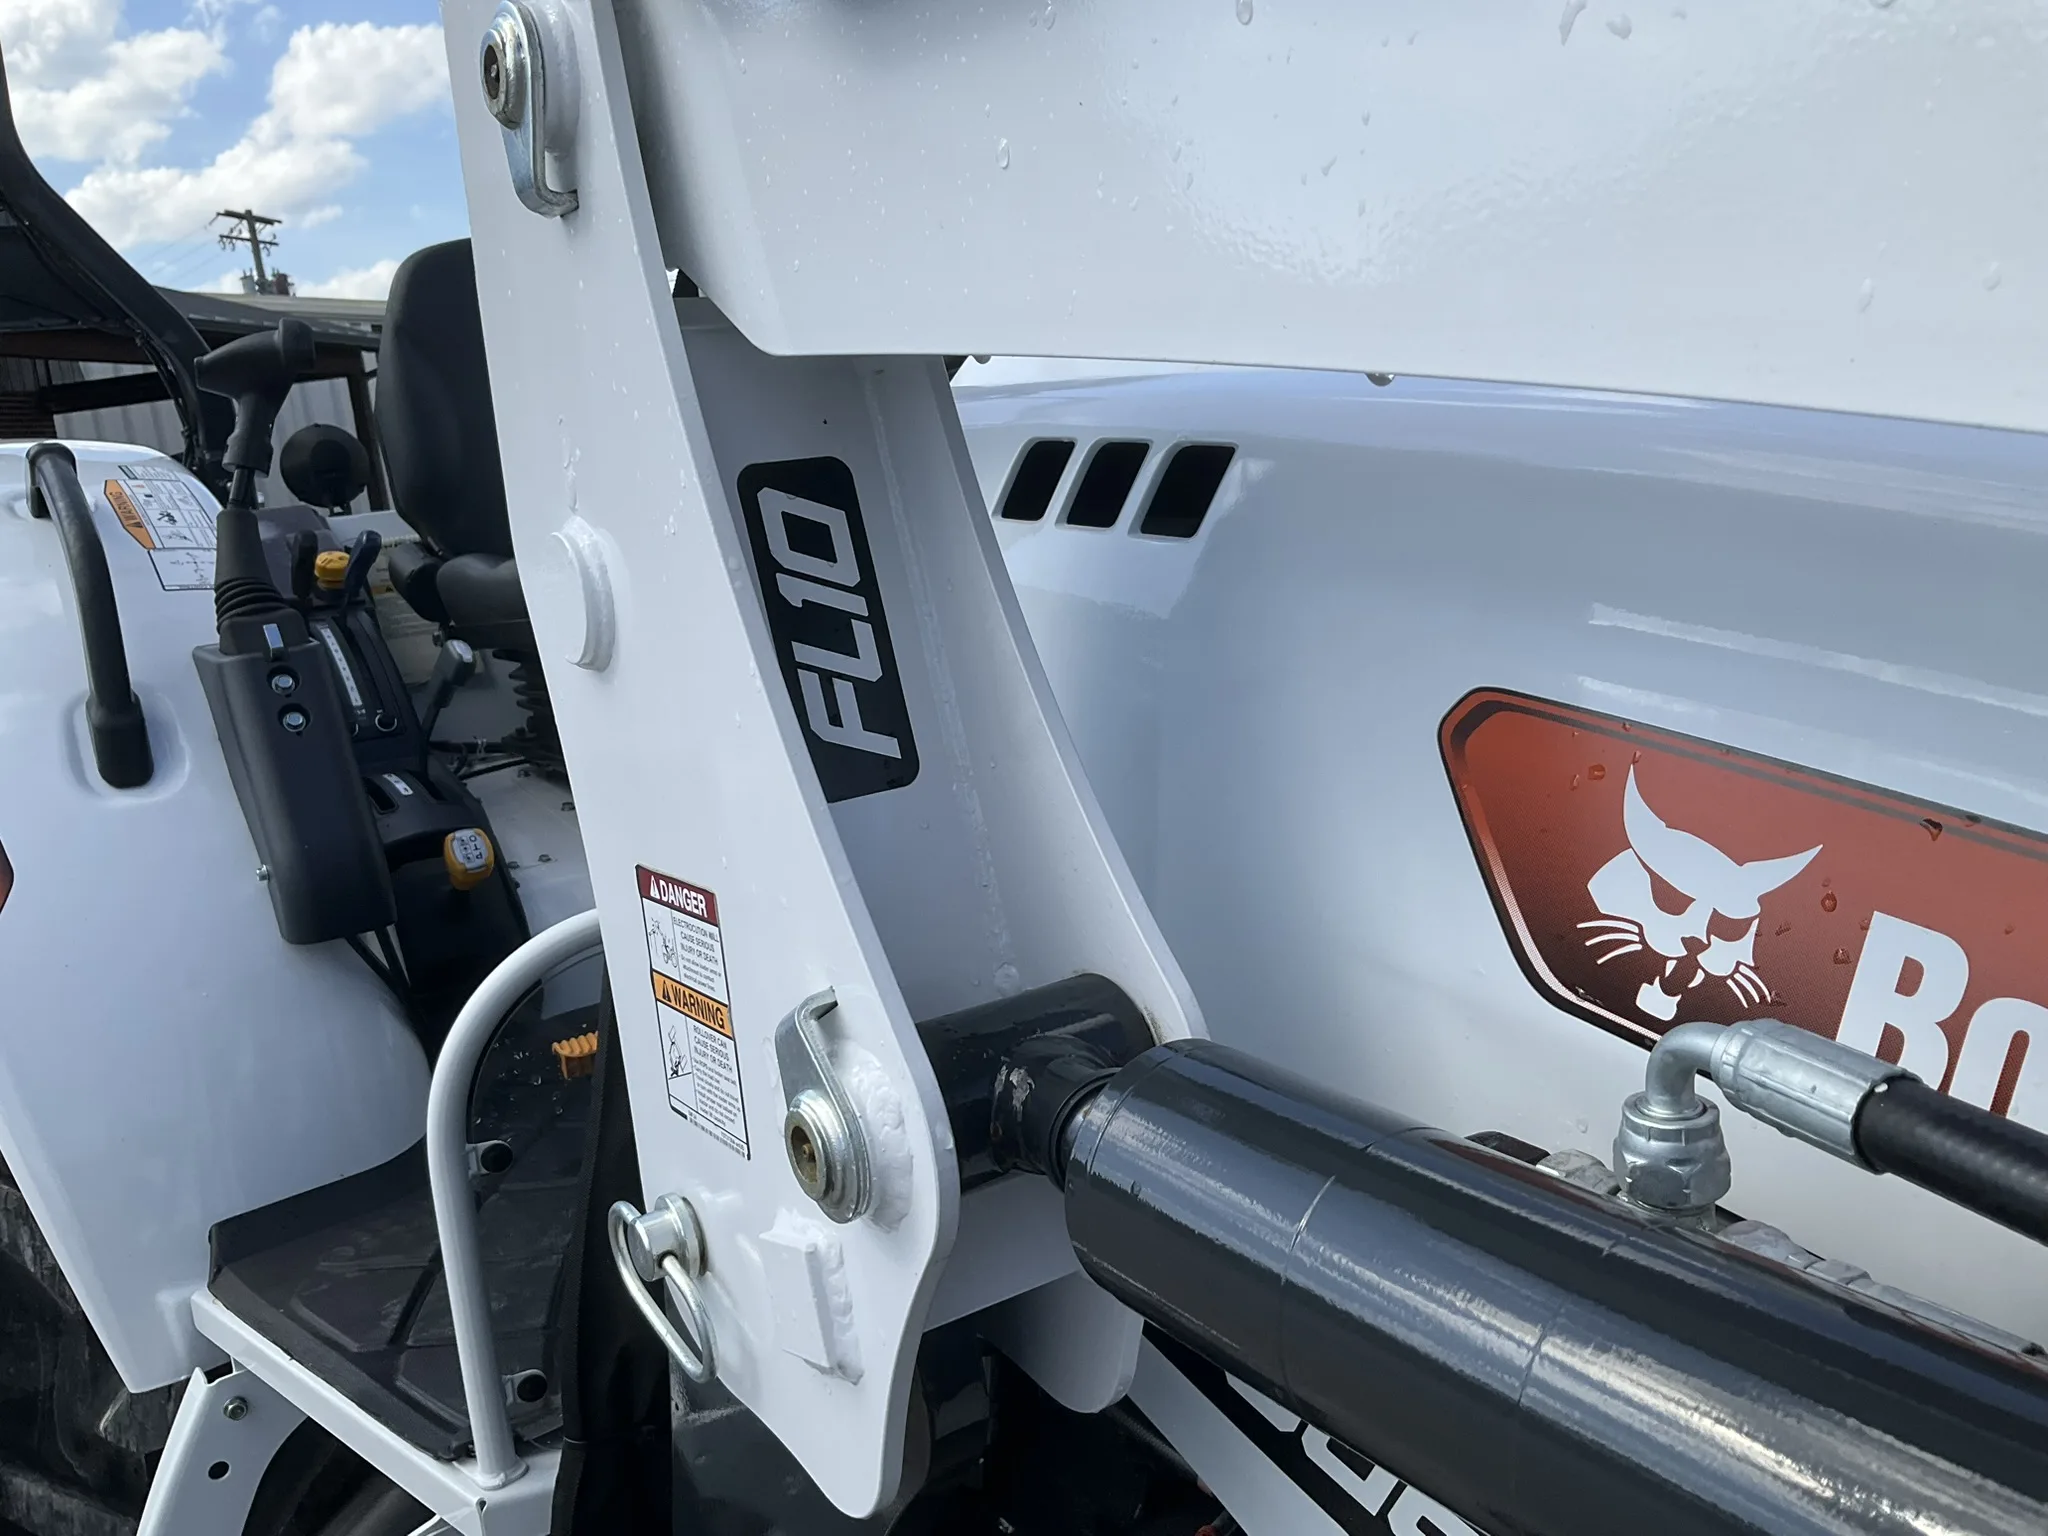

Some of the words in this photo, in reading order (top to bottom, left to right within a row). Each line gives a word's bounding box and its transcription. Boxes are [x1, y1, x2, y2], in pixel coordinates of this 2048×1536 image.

[109, 491, 138, 524] WARNING
[757, 486, 902, 760] FL10
[659, 878, 707, 918] DANGER
[680, 930, 695, 944] CAUSE
[695, 936, 714, 953] SERIOUS
[671, 983, 724, 1030] WARNING
[693, 1034, 709, 1050] CAUSE
[709, 1043, 729, 1061] SERIOUS
